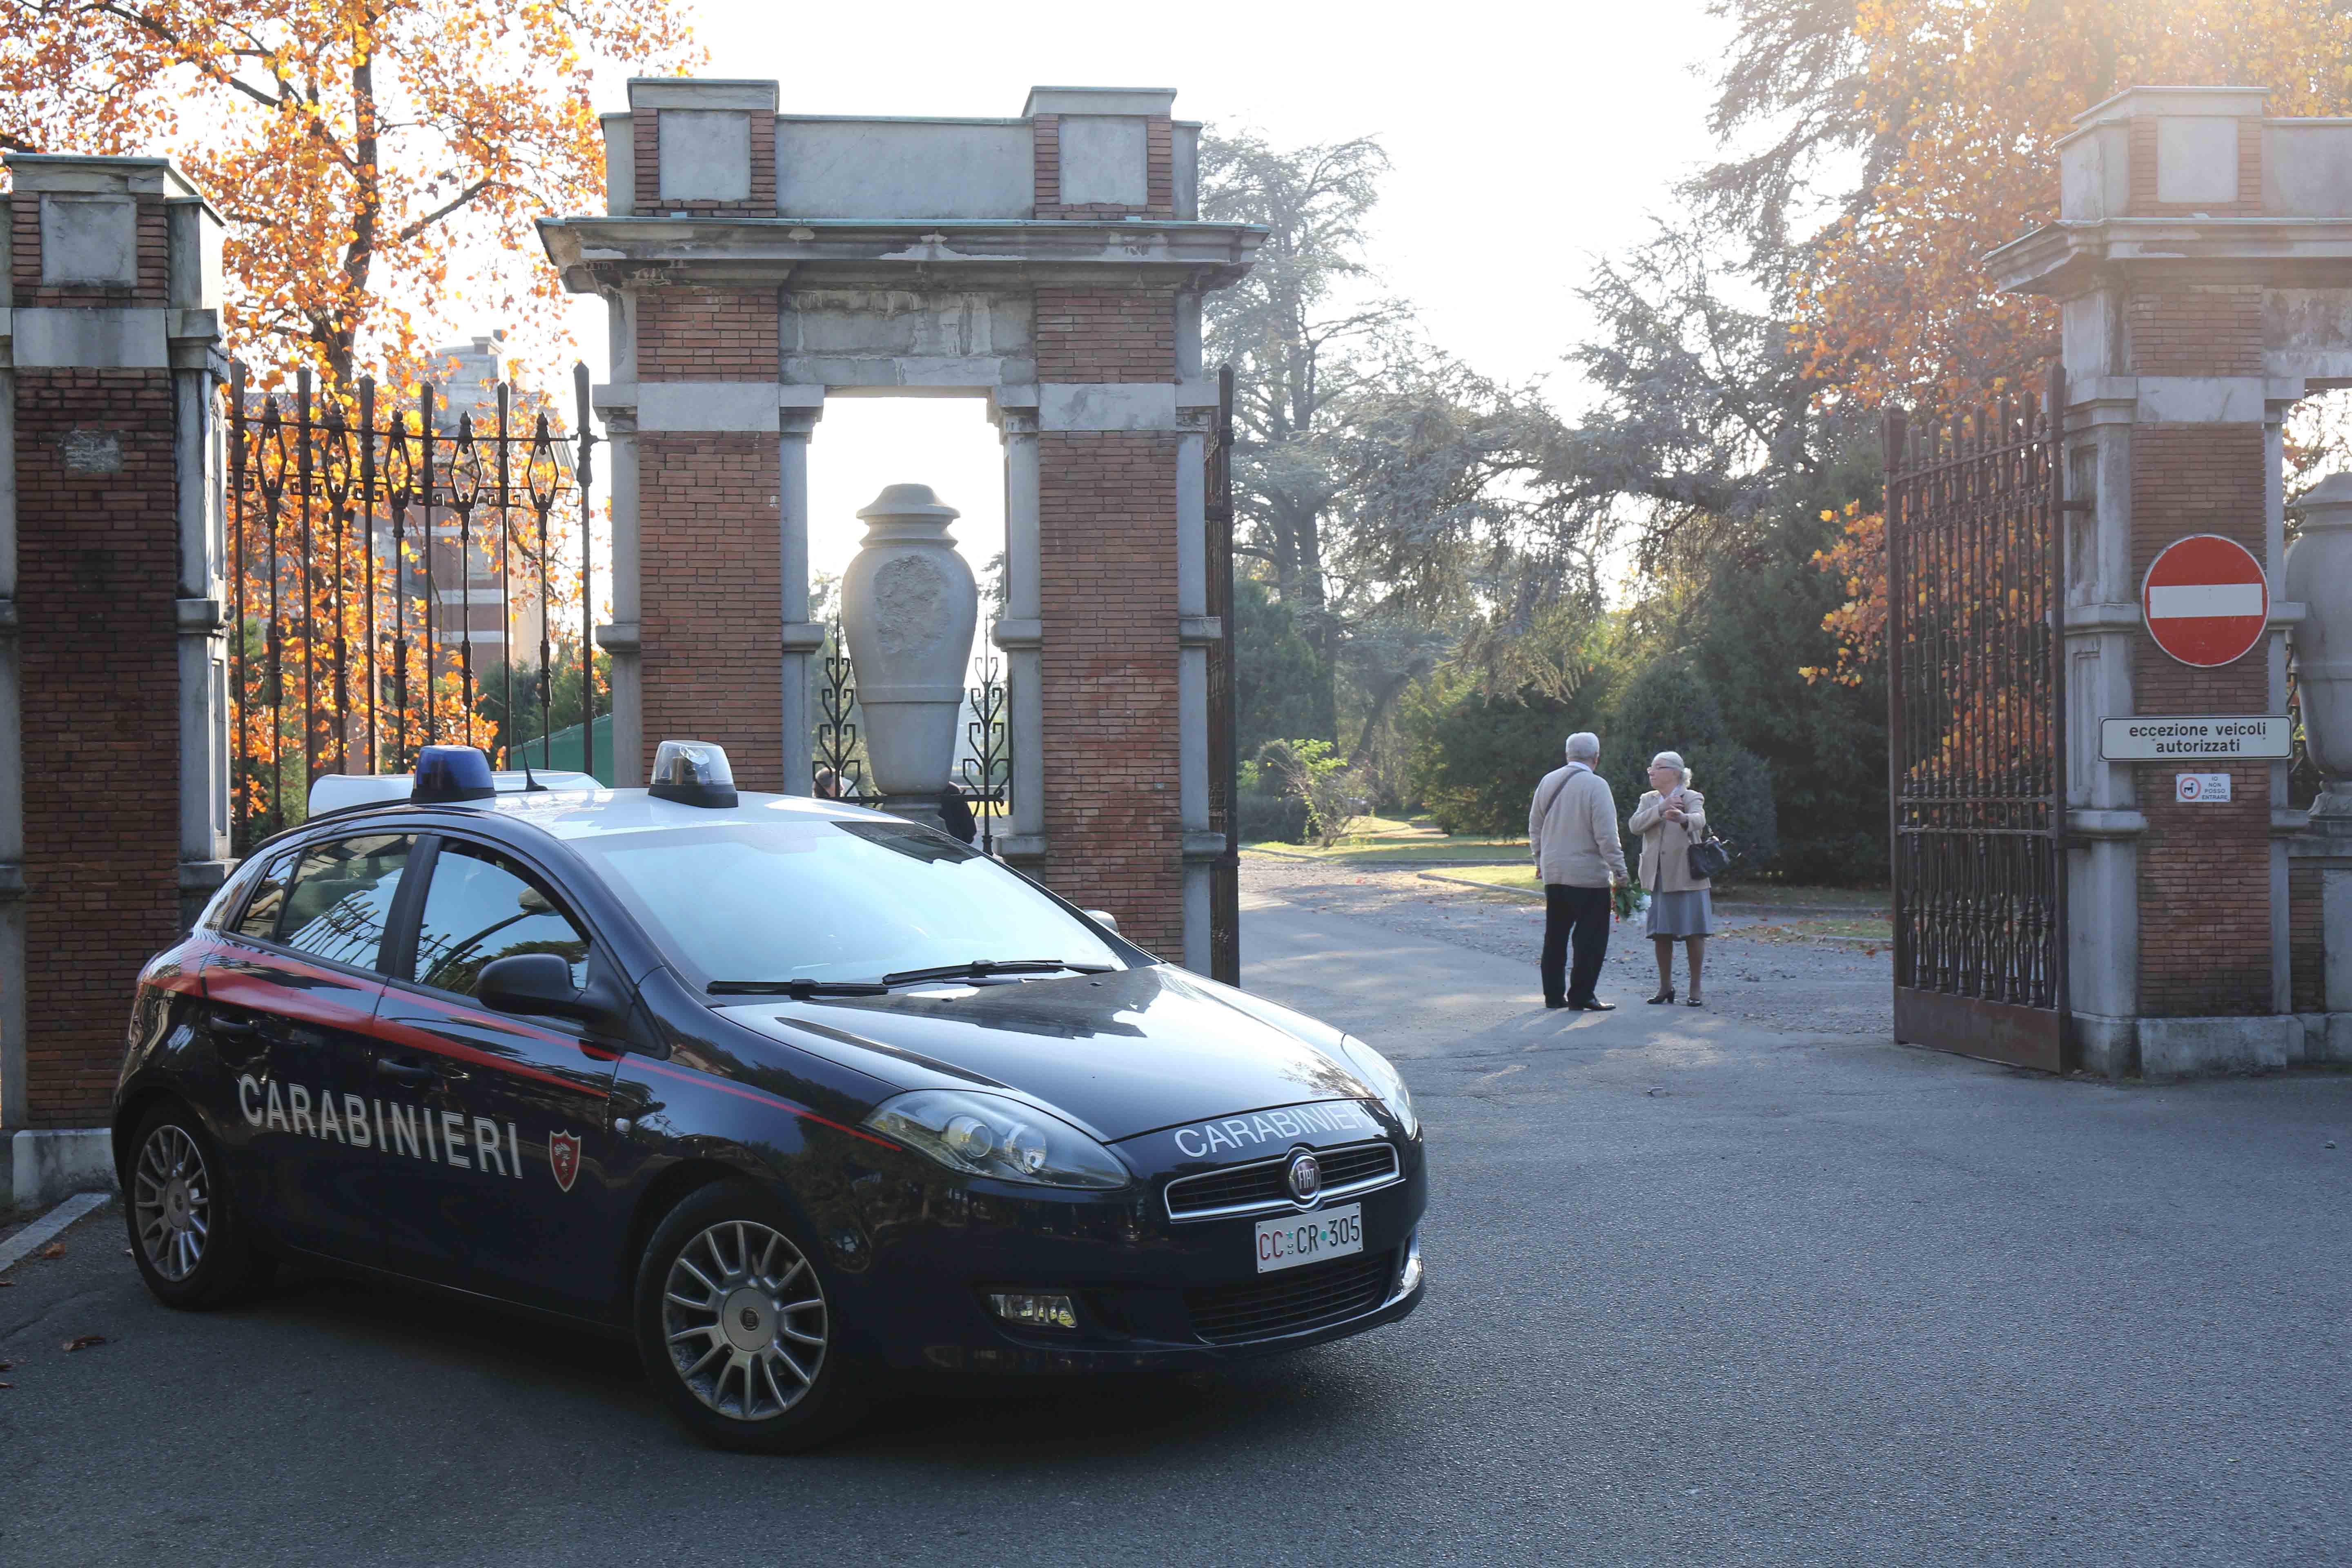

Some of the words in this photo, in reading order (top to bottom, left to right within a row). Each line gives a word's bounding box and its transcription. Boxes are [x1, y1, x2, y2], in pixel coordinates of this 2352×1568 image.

[2129, 723, 2208, 737] eccezione
[2216, 722, 2266, 736] veicoli
[2156, 739, 2240, 753] autorizzati
[239, 1074, 523, 1179] CARABINIERI
[1298, 1168, 1314, 1189] FIAT
[1328, 1214, 1359, 1247] 305
